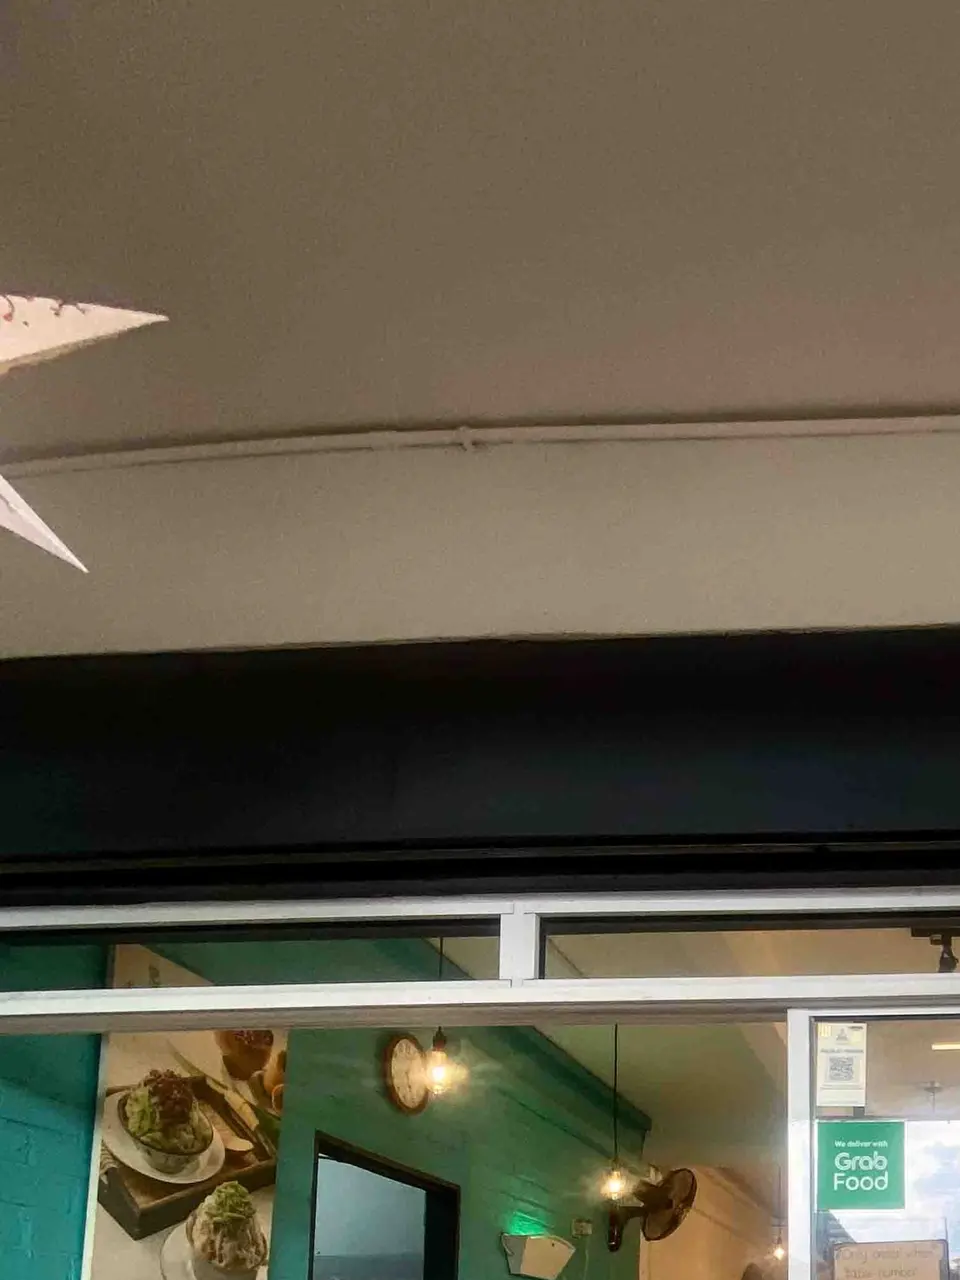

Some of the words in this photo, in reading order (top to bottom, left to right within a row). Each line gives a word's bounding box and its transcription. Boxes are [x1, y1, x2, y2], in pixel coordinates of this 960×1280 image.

[834, 1140, 846, 1148] We
[847, 1140, 872, 1148] deliver
[872, 1140, 888, 1148] with
[834, 1151, 888, 1171] Grab
[833, 1171, 889, 1191] Food
